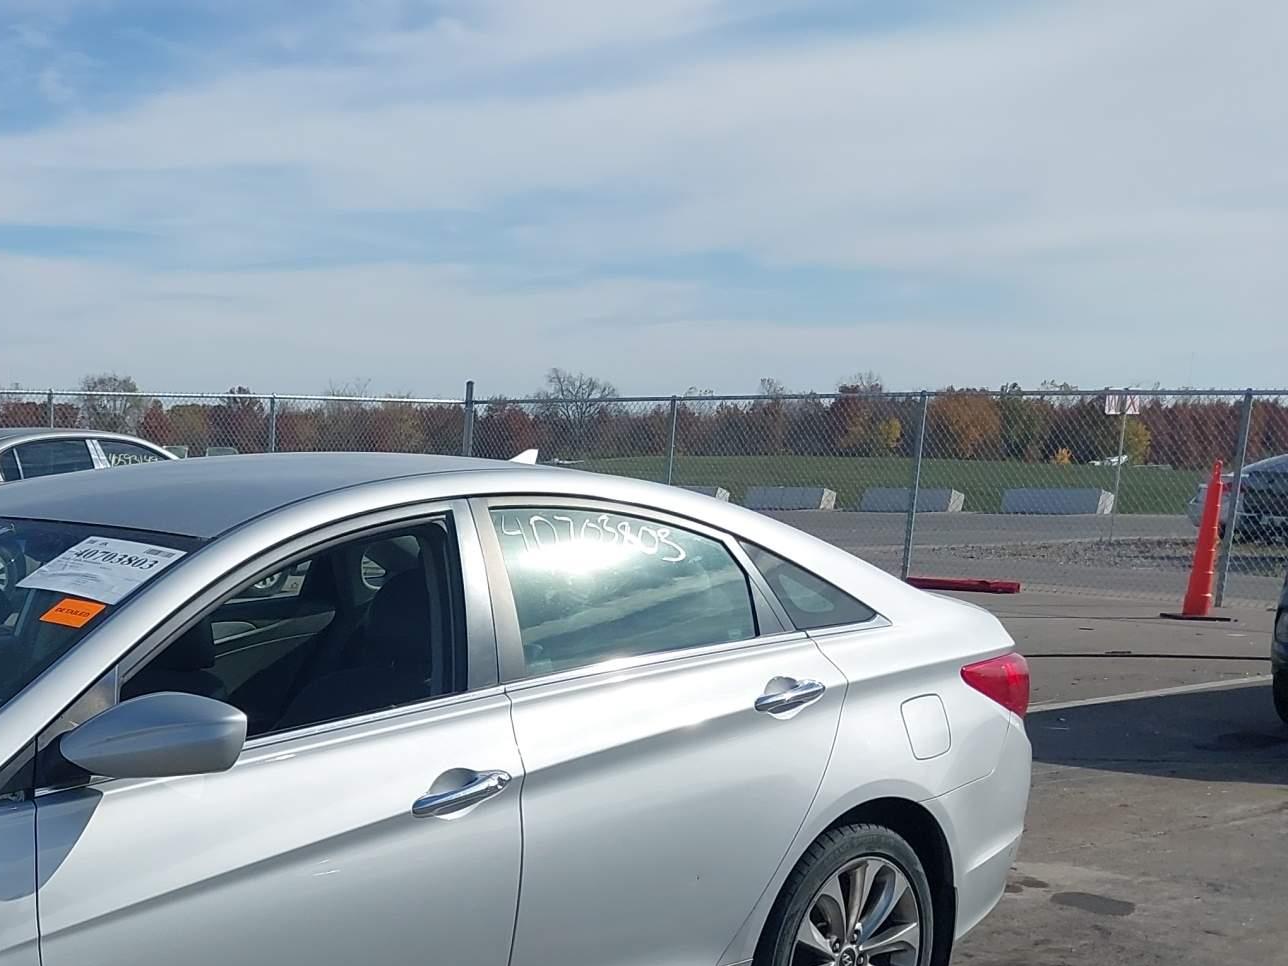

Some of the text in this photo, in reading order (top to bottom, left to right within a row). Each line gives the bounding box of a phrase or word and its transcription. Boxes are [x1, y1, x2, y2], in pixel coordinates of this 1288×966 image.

[501, 513, 687, 562] 40703803
[74, 549, 160, 570] 40703803
[53, 607, 91, 618] DETAILED
